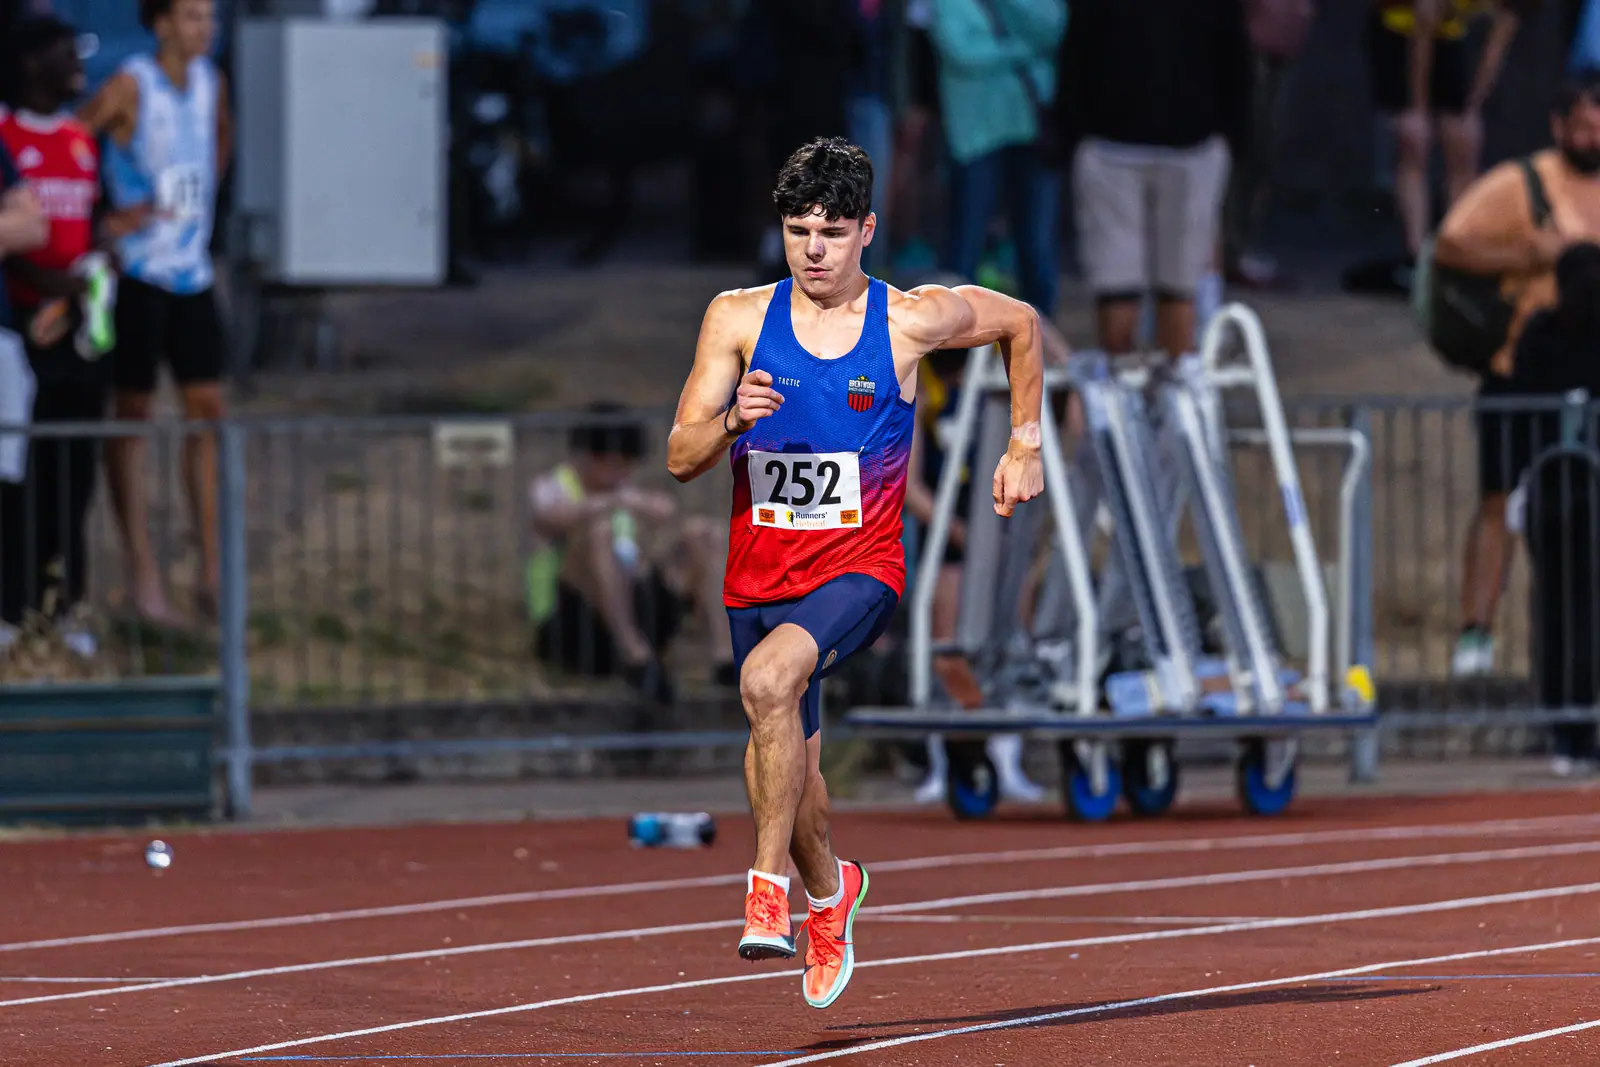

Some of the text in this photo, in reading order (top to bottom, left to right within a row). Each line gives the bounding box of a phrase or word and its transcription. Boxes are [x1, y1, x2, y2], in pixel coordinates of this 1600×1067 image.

[778, 376, 800, 387] TACTIC
[765, 460, 841, 506] 252
[795, 511, 828, 519] Runners'
